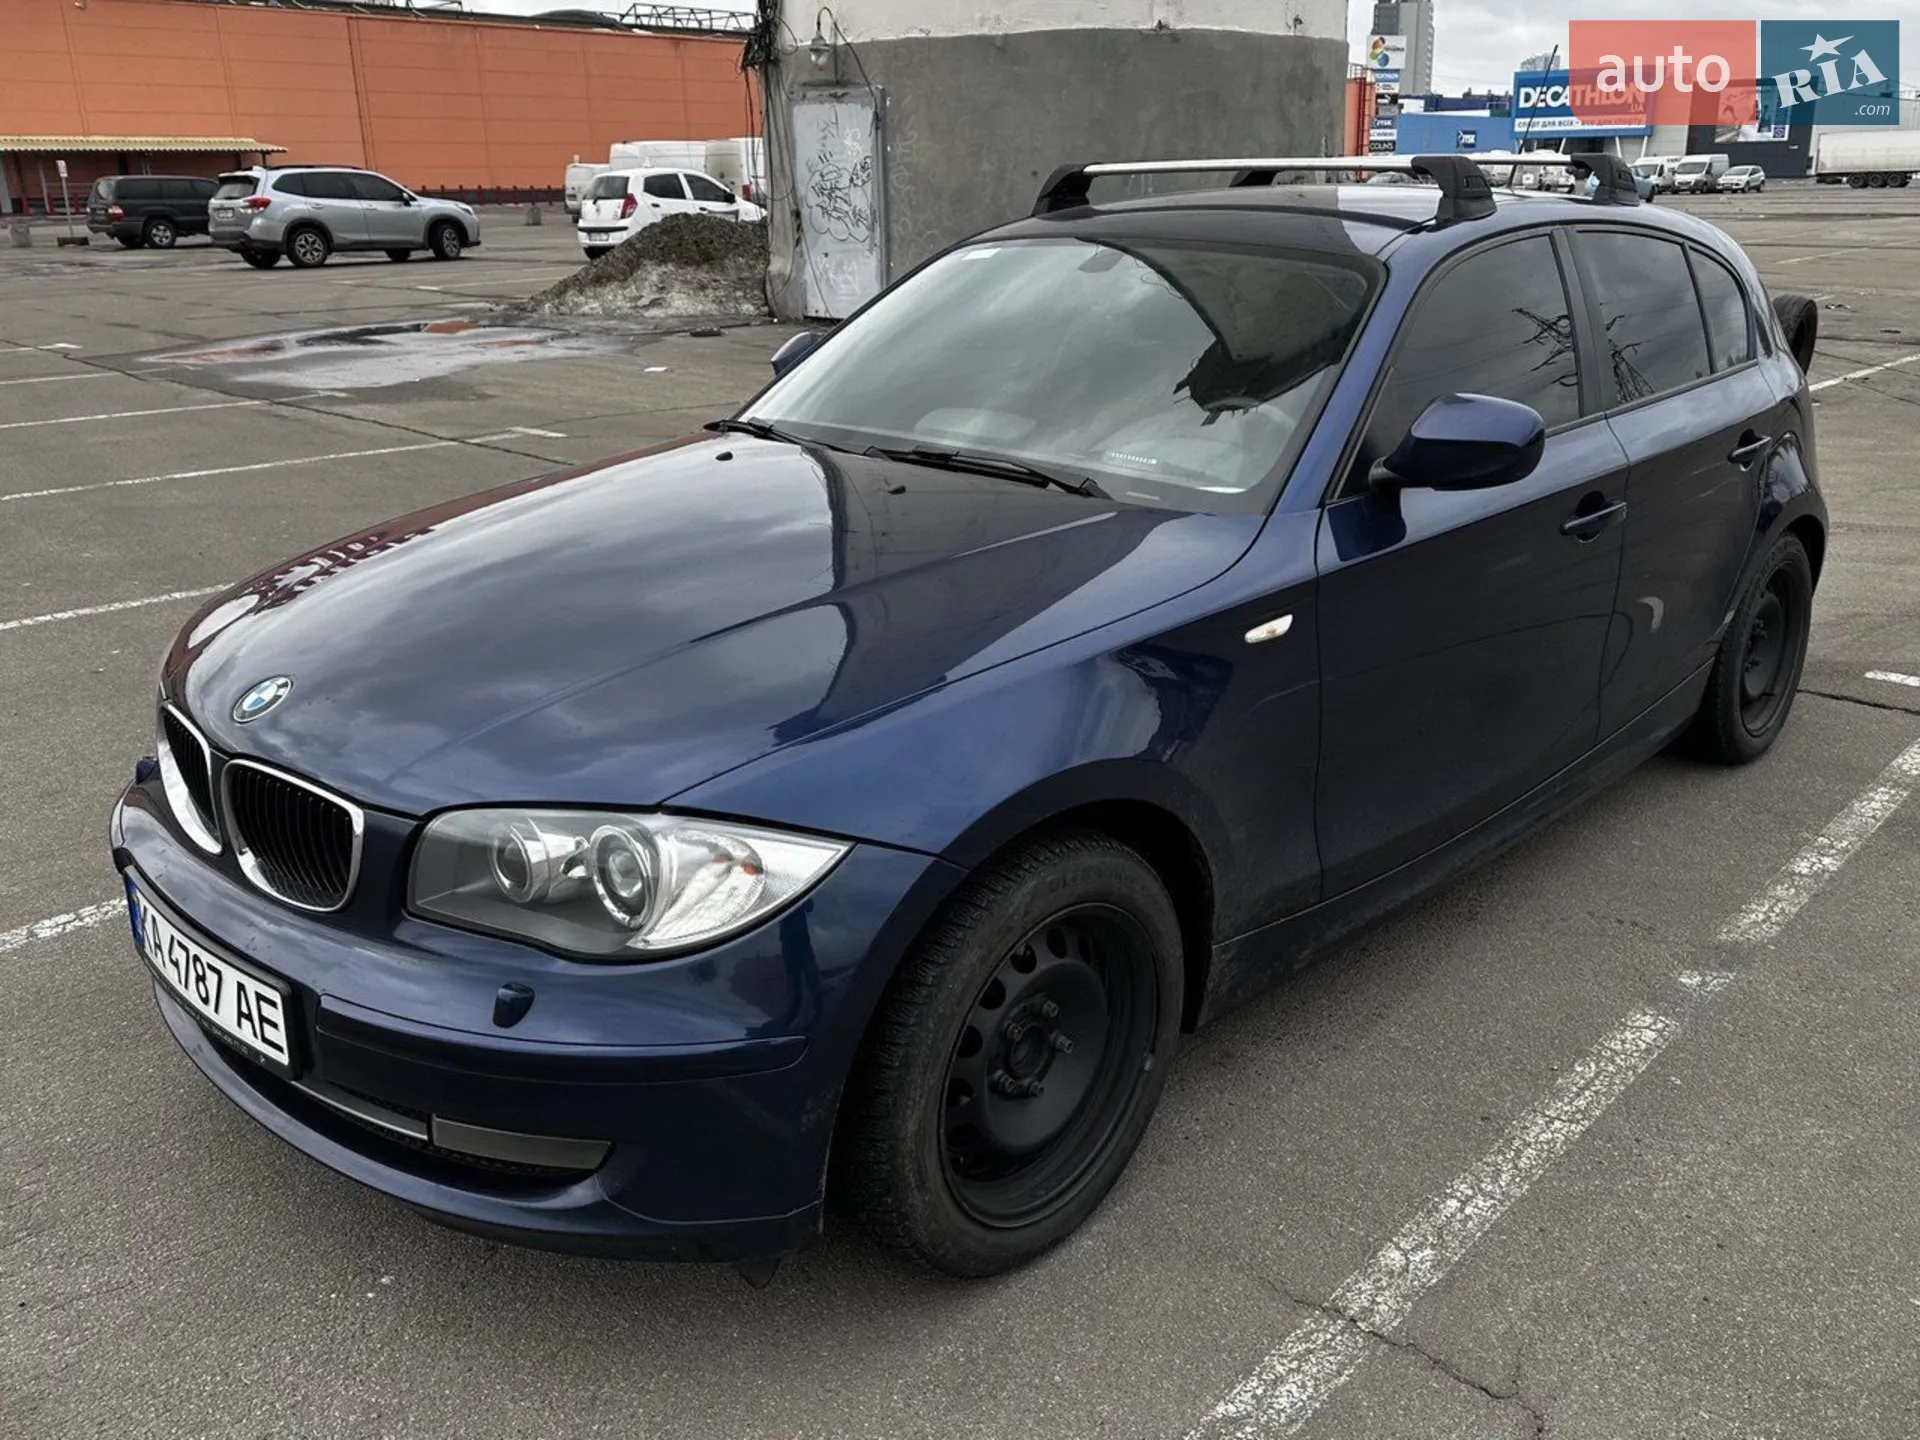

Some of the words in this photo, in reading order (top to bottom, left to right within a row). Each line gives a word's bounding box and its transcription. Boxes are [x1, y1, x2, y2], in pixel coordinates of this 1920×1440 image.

[1518, 82, 1646, 109] DECATHLON
[1517, 120, 1541, 129] спрт
[141, 904, 167, 969] KA
[168, 934, 223, 1015] 4787
[236, 980, 286, 1056] AE
